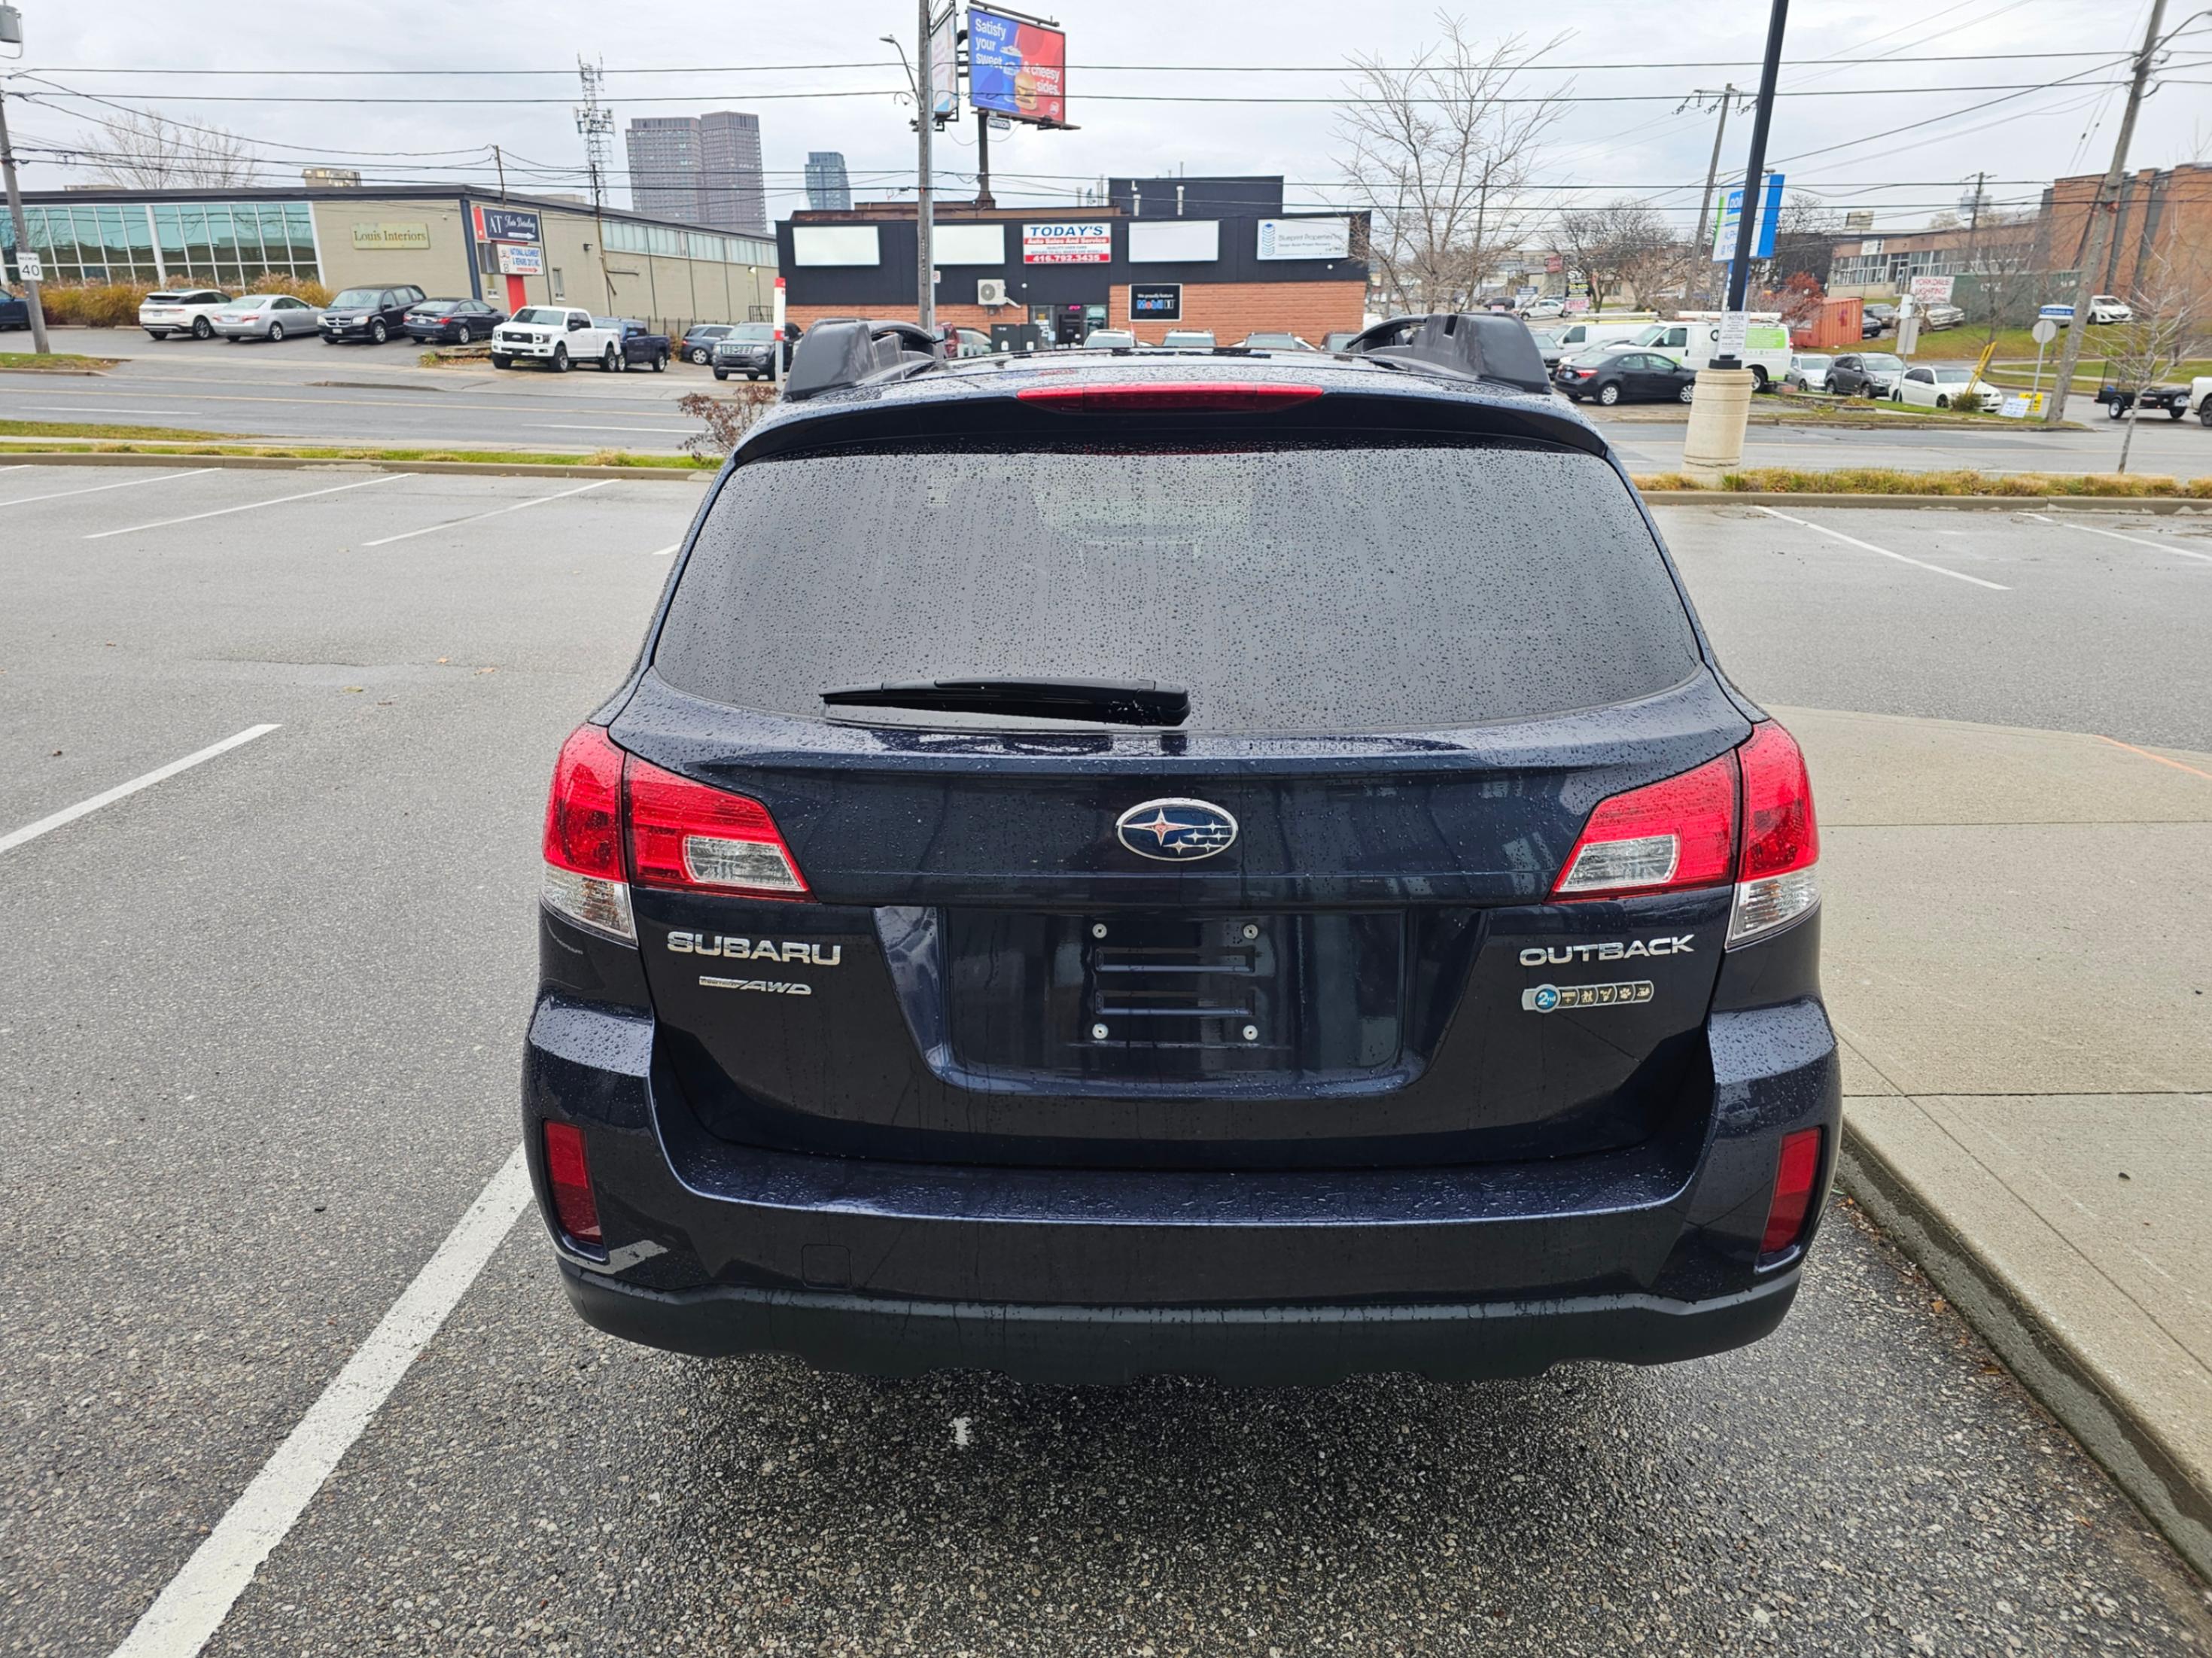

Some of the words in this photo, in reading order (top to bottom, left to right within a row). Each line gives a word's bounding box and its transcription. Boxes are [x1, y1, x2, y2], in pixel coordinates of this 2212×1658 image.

[975, 18, 1006, 41] Satisfy
[975, 37, 996, 51] your
[975, 53, 1003, 69] sweet
[1031, 63, 1060, 83] cheesy
[490, 215, 502, 233] AT
[1030, 226, 1103, 236] TODAY'S
[354, 230, 382, 241] Louis
[384, 230, 427, 241] Interiors
[1033, 254, 1100, 263] 416.792.3435
[22, 264, 40, 276] 40
[1915, 278, 1951, 286] YORKDALE
[1136, 300, 1164, 309] Mobil
[667, 931, 841, 966] SUBARU
[1520, 934, 1695, 966] OUTBACK
[740, 980, 812, 996] AWD
[1537, 991, 1556, 1005] 2nd
